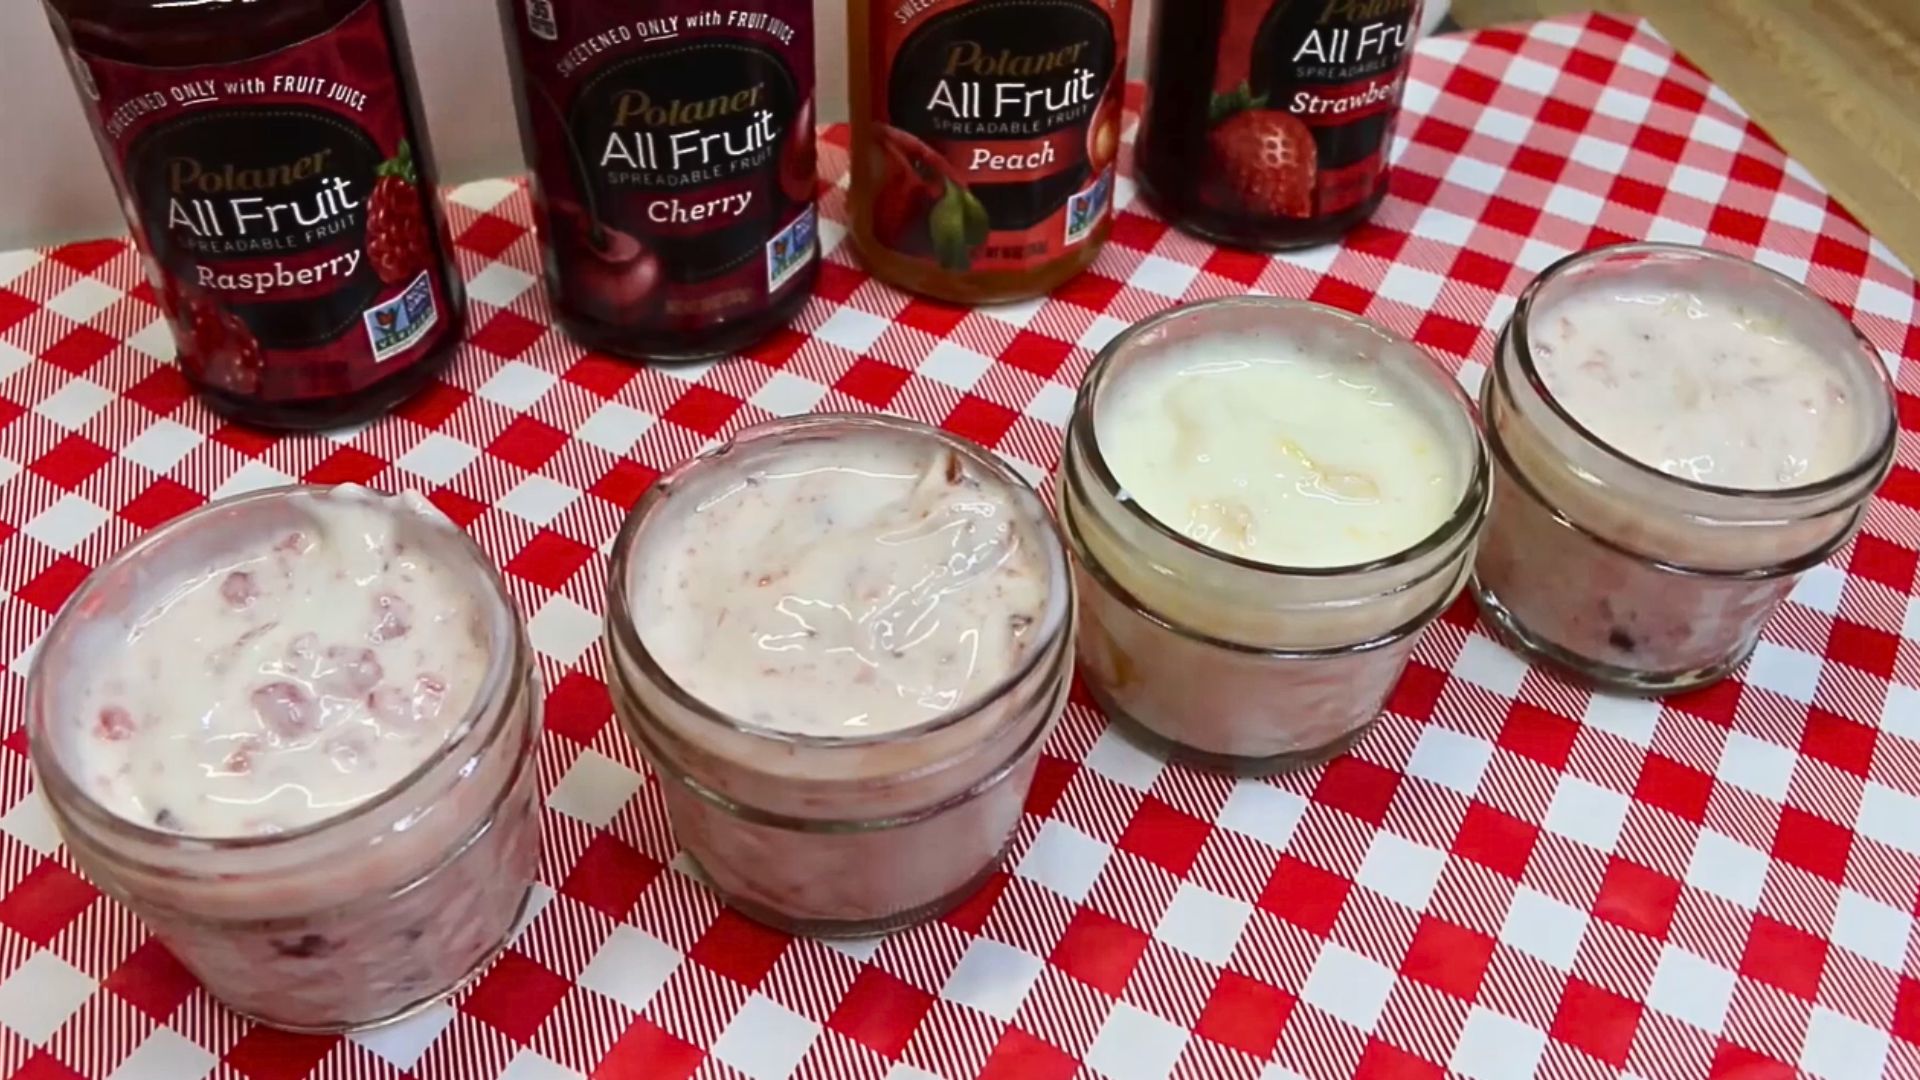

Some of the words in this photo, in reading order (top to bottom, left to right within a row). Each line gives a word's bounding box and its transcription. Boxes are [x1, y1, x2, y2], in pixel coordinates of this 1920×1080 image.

[556, 25, 632, 78] SWEETENED
[635, 16, 679, 38] ONLY
[686, 10, 722, 28] with
[727, 10, 769, 30] FRUIT
[767, 17, 795, 46] JUICE
[946, 40, 1086, 77] Polaner
[1292, 28, 1349, 63] All
[1355, 23, 1405, 61] Fru
[106, 91, 168, 139] SWEETENED
[170, 79, 216, 102] ONLY
[224, 77, 266, 95] with
[273, 75, 326, 96] FRUIT
[327, 82, 367, 112] JUICE
[604, 86, 763, 127] Polaner
[926, 79, 980, 118] All
[994, 68, 1095, 118] Fruit
[600, 131, 658, 170] All
[668, 109, 777, 170] Fruit
[932, 116, 1041, 135] SPREADABLE
[1047, 104, 1089, 127] FRUIT
[168, 151, 330, 194] Polaner
[608, 165, 722, 187] SPREADABLE
[730, 146, 773, 171] FRUIT
[968, 140, 1056, 171] Peach
[168, 198, 224, 237] All
[229, 176, 359, 235] Fruit
[648, 191, 753, 223] Cherry
[305, 214, 356, 243] FRUIT
[196, 249, 361, 294] Raspberry
